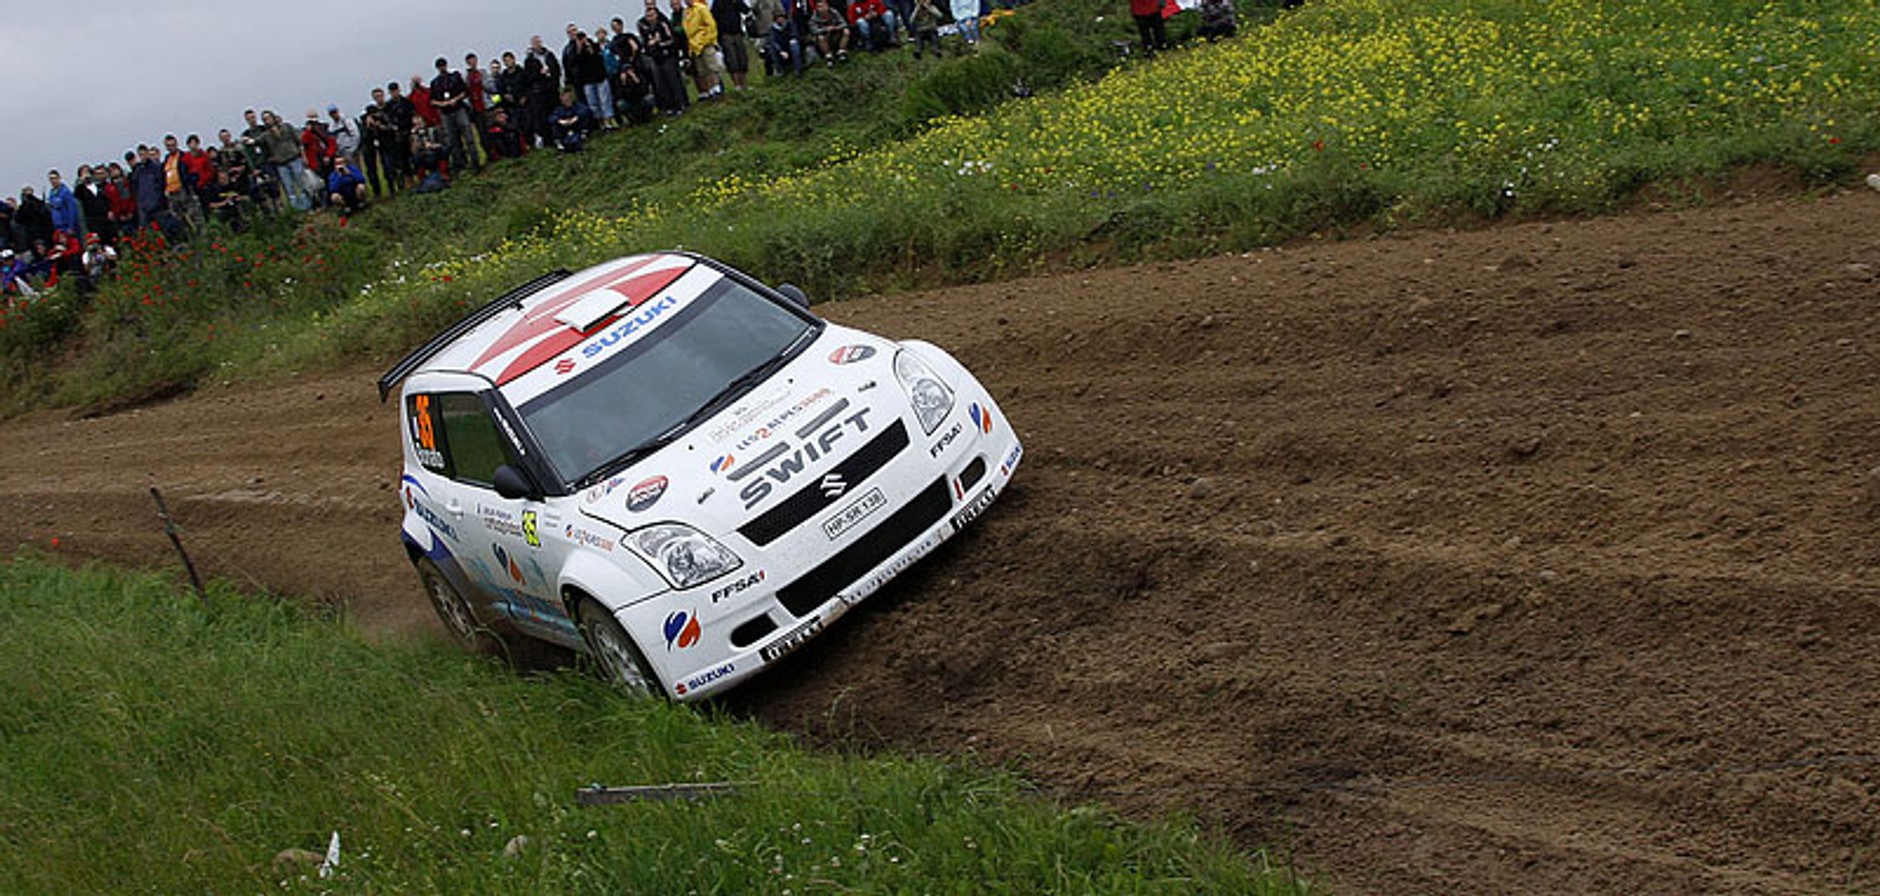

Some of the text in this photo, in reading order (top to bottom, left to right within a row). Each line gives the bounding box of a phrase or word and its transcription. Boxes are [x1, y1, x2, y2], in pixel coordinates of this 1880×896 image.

[582, 296, 677, 358] SUZUKI
[740, 407, 871, 511] SWIFT
[688, 663, 735, 690] SUZUKI
